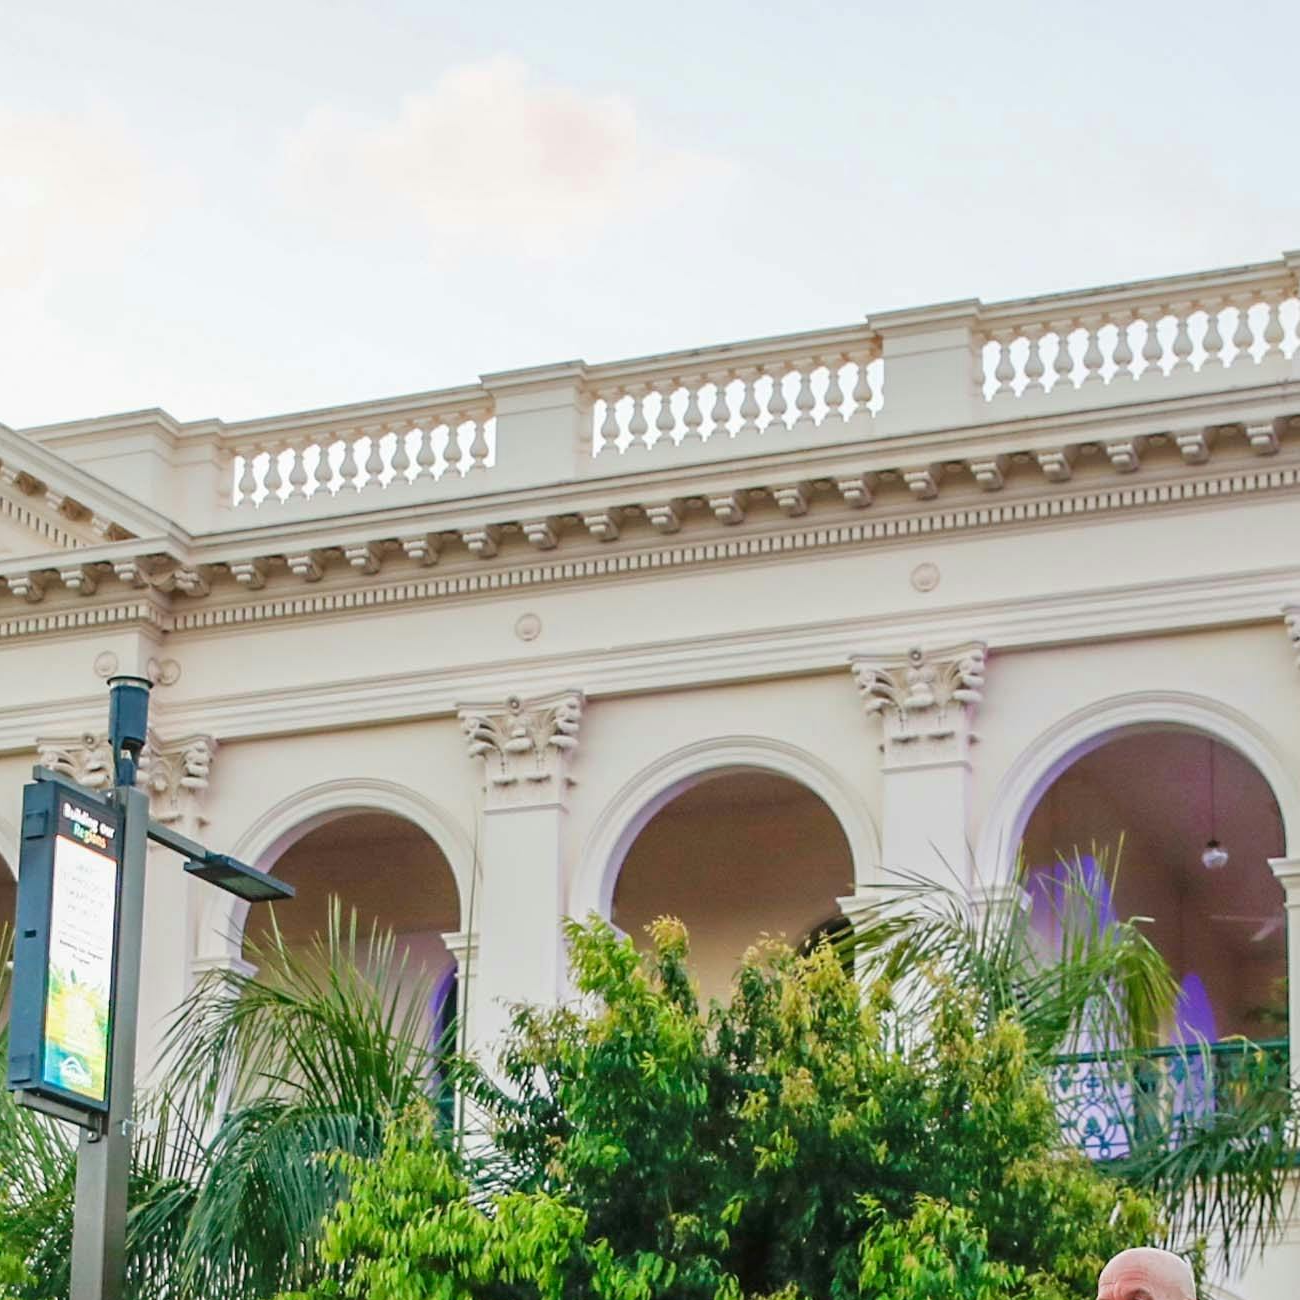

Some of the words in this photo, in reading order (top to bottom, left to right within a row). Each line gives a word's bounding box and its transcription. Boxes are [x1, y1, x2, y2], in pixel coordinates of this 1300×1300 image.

[62, 802, 99, 834] Building
[99, 822, 116, 840] our
[73, 822, 107, 849] Regions
